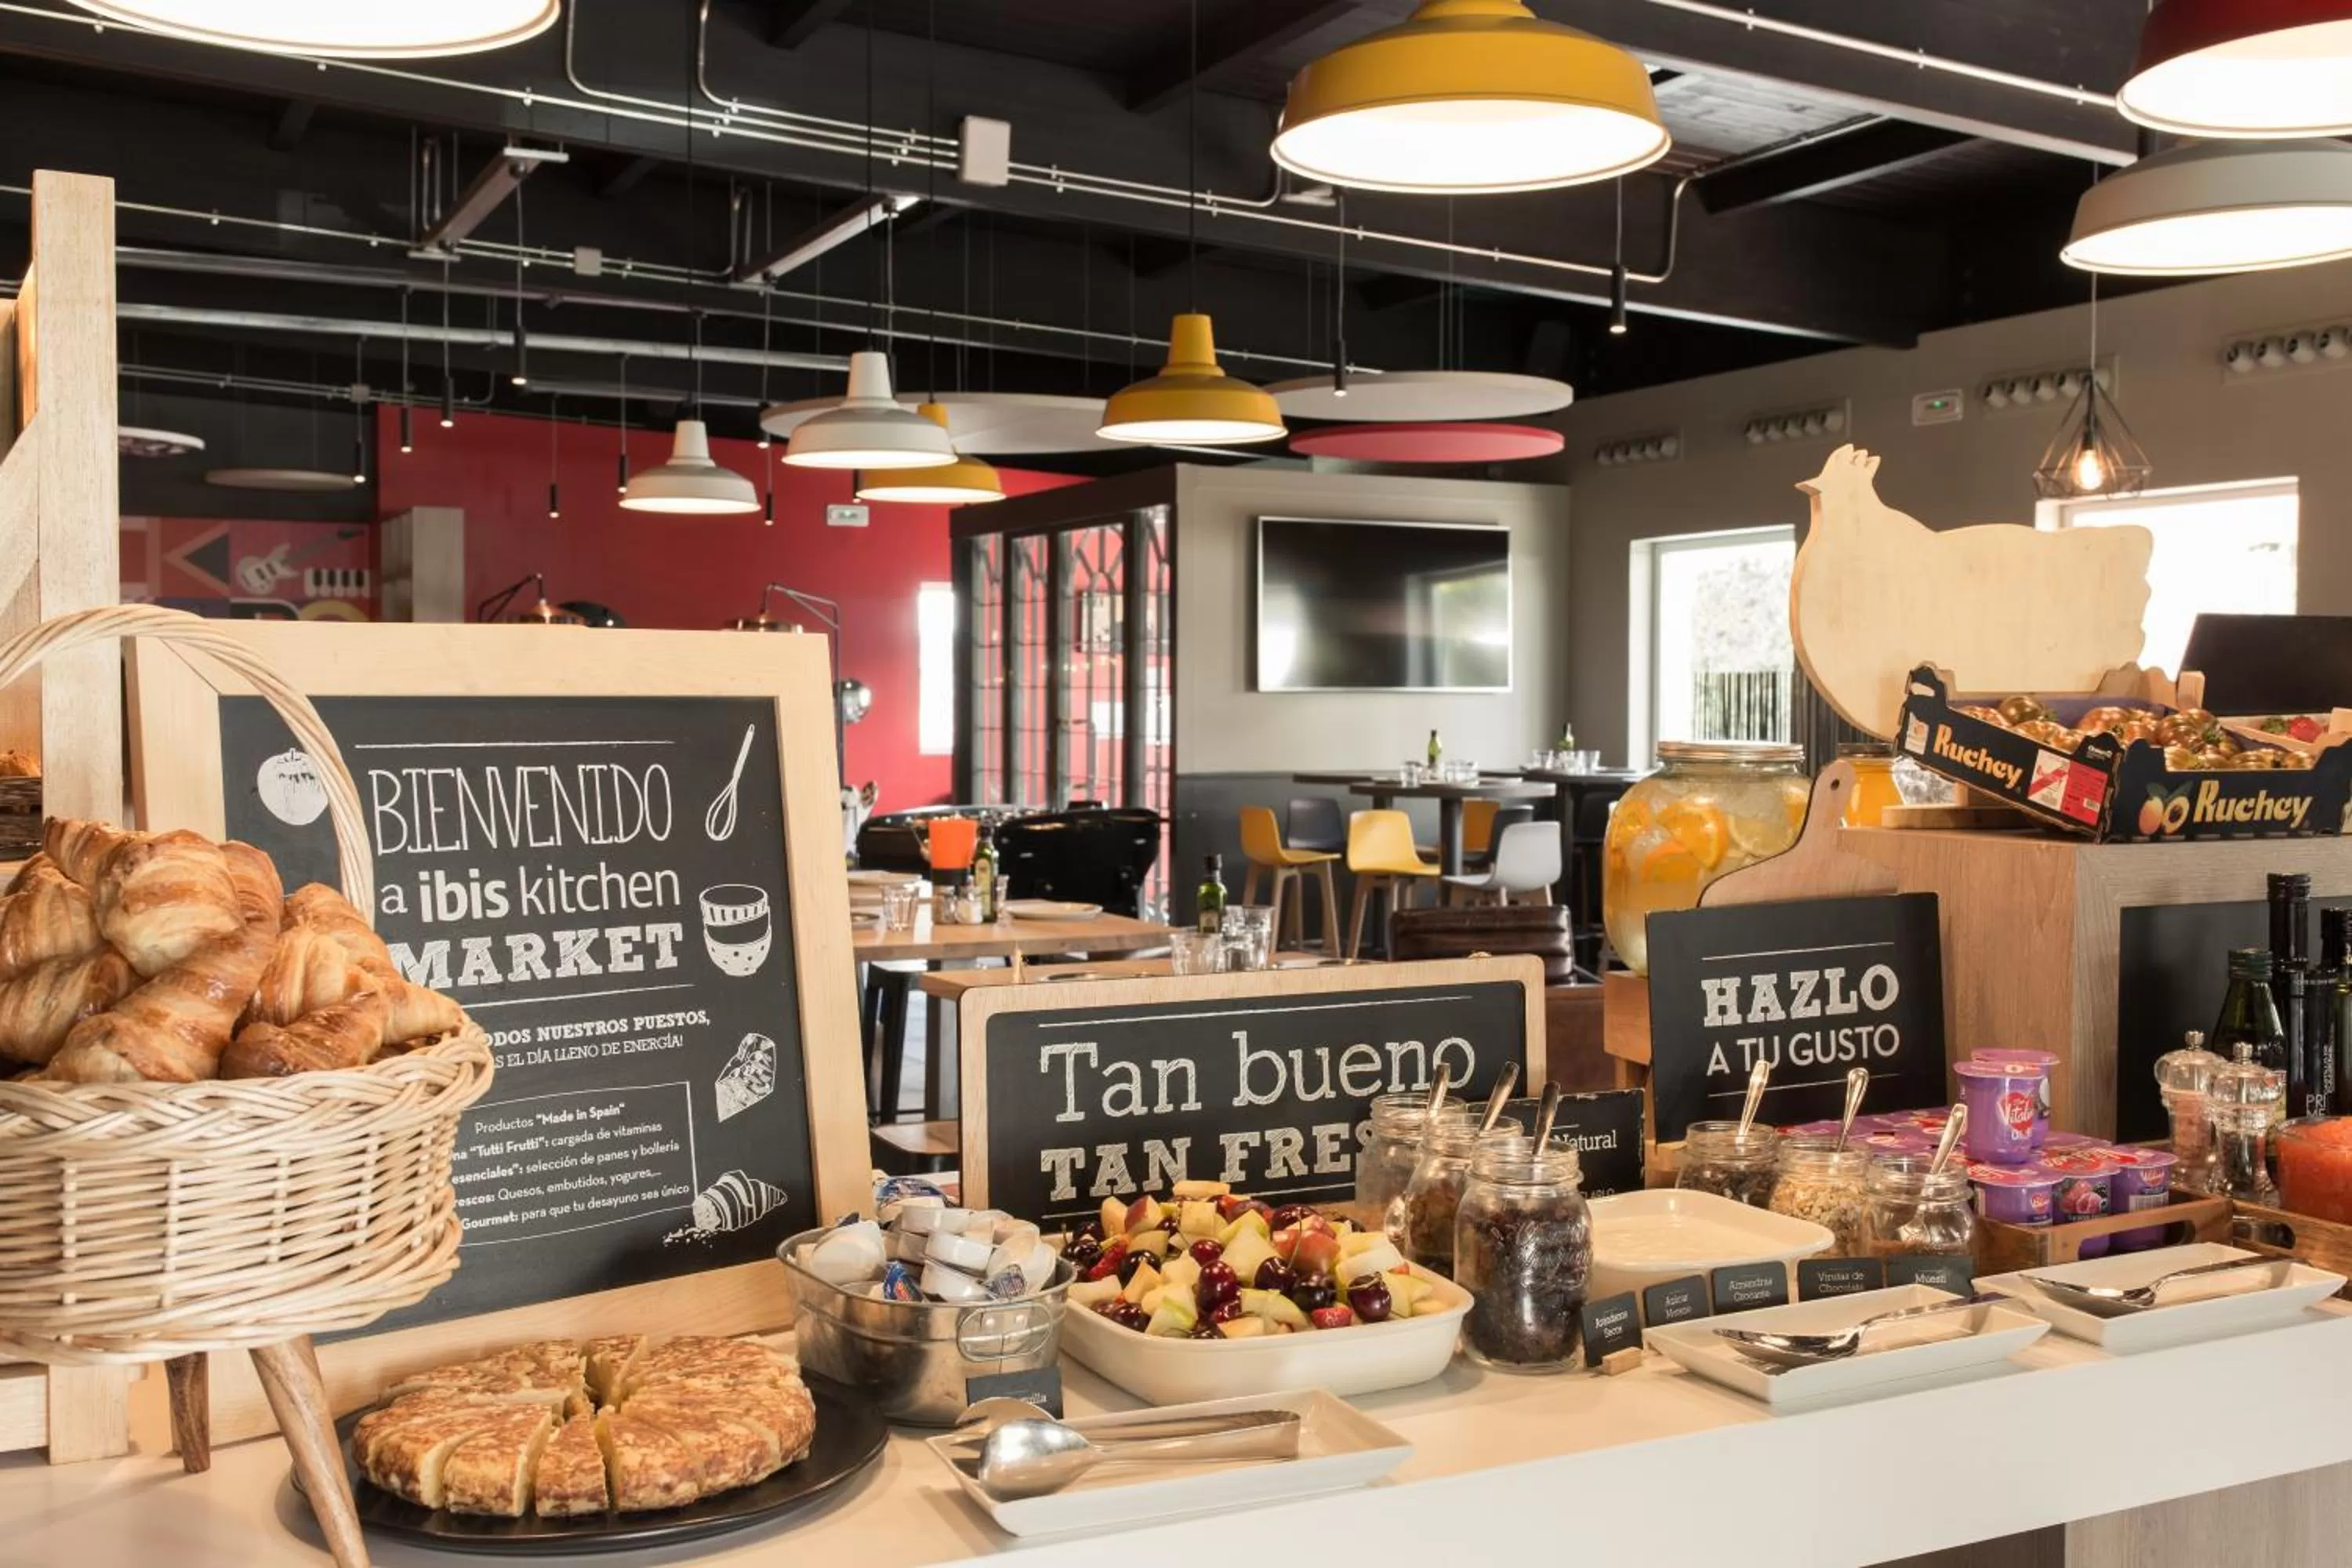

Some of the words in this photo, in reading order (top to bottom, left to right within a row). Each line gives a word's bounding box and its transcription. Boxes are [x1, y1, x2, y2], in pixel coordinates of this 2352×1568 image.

[1933, 724, 2023, 789] Ruchey
[368, 764, 672, 856] BIENVENIDO
[2193, 779, 2314, 829] Ruchey
[381, 883, 408, 915] a
[418, 868, 510, 923] ibis
[520, 862, 681, 916] kitchen
[387, 922, 684, 989] MARKET
[1700, 964, 1900, 1028] HAZLO
[483, 1029, 532, 1047] ODOS
[536, 1018, 628, 1043] NUESTROS
[633, 1009, 711, 1032] PUESTOS,
[1706, 1041, 1731, 1076] A
[1737, 1035, 1781, 1072] TU
[1788, 1023, 1900, 1066] GUSTO
[508, 1052, 524, 1067] EL
[527, 1047, 553, 1064] DÍA
[554, 1044, 599, 1062] LLENO
[601, 1041, 620, 1056] DE
[1039, 1041, 1201, 1123] Tan
[1230, 1029, 1477, 1108] bueno
[451, 1151, 468, 1161] na
[551, 1129, 594, 1148] cargada
[597, 1126, 611, 1139] de
[612, 1122, 663, 1138] vitaminas
[474, 1116, 535, 1134] Productos
[576, 1108, 588, 1121] in
[526, 1155, 579, 1174] selección
[580, 1152, 595, 1165] de
[597, 1149, 630, 1167] panes
[631, 1148, 638, 1161] y
[1040, 1137, 1192, 1202] TAN
[1219, 1119, 1374, 1183] FRE
[454, 1194, 495, 1207] rescos:
[546, 1173, 608, 1194] embutidos,
[461, 1211, 519, 1230] Gourmet:
[521, 1208, 547, 1224] para
[549, 1204, 571, 1218] que
[573, 1200, 586, 1212] tu
[587, 1193, 640, 1212] desayuno
[641, 1189, 660, 1202] sea
[661, 1184, 691, 1199] único
